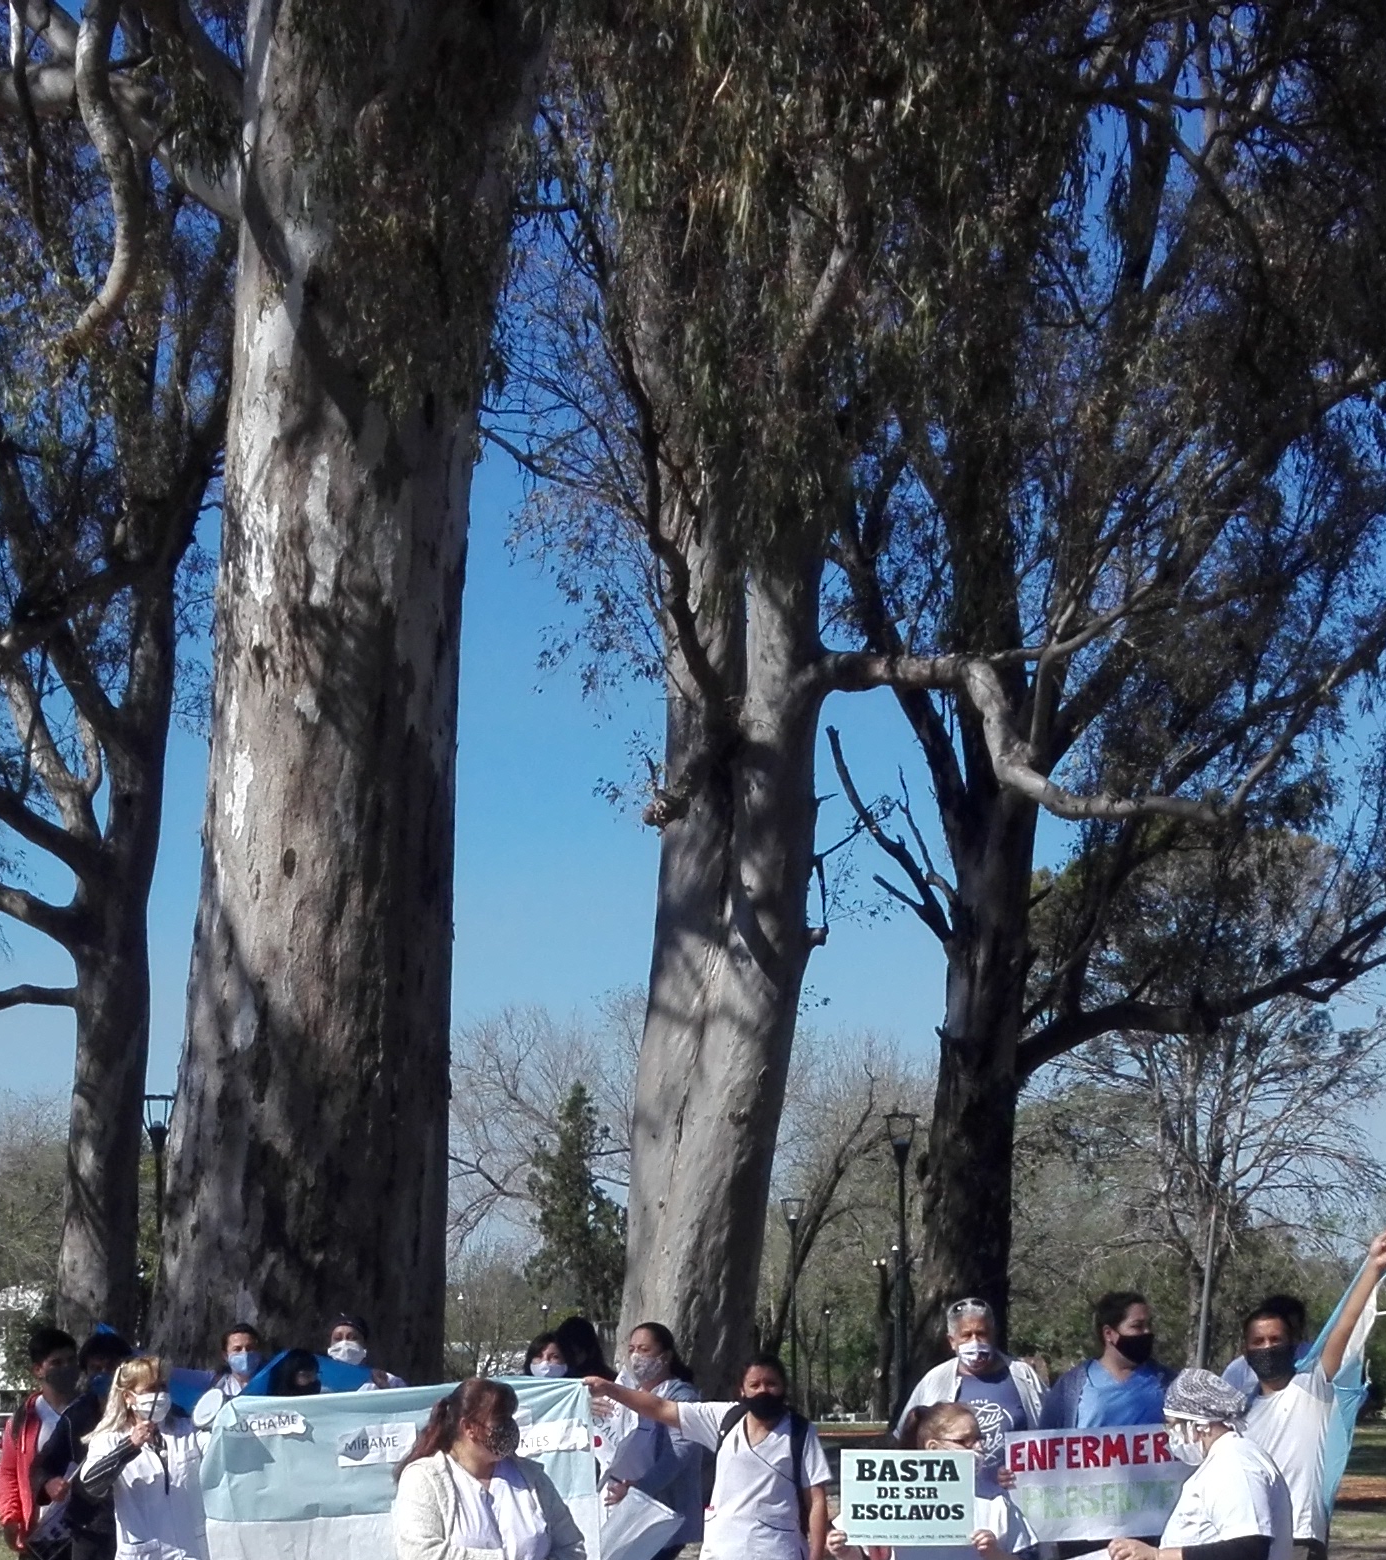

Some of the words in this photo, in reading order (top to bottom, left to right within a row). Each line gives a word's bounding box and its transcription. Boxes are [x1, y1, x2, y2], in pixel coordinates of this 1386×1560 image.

[1009, 1430, 1175, 1473] ENFERMER
[856, 1458, 960, 1482] BASTA
[876, 1486, 900, 1499] DE
[904, 1486, 939, 1499] SER
[851, 1503, 965, 1520] ESCLAVOS
